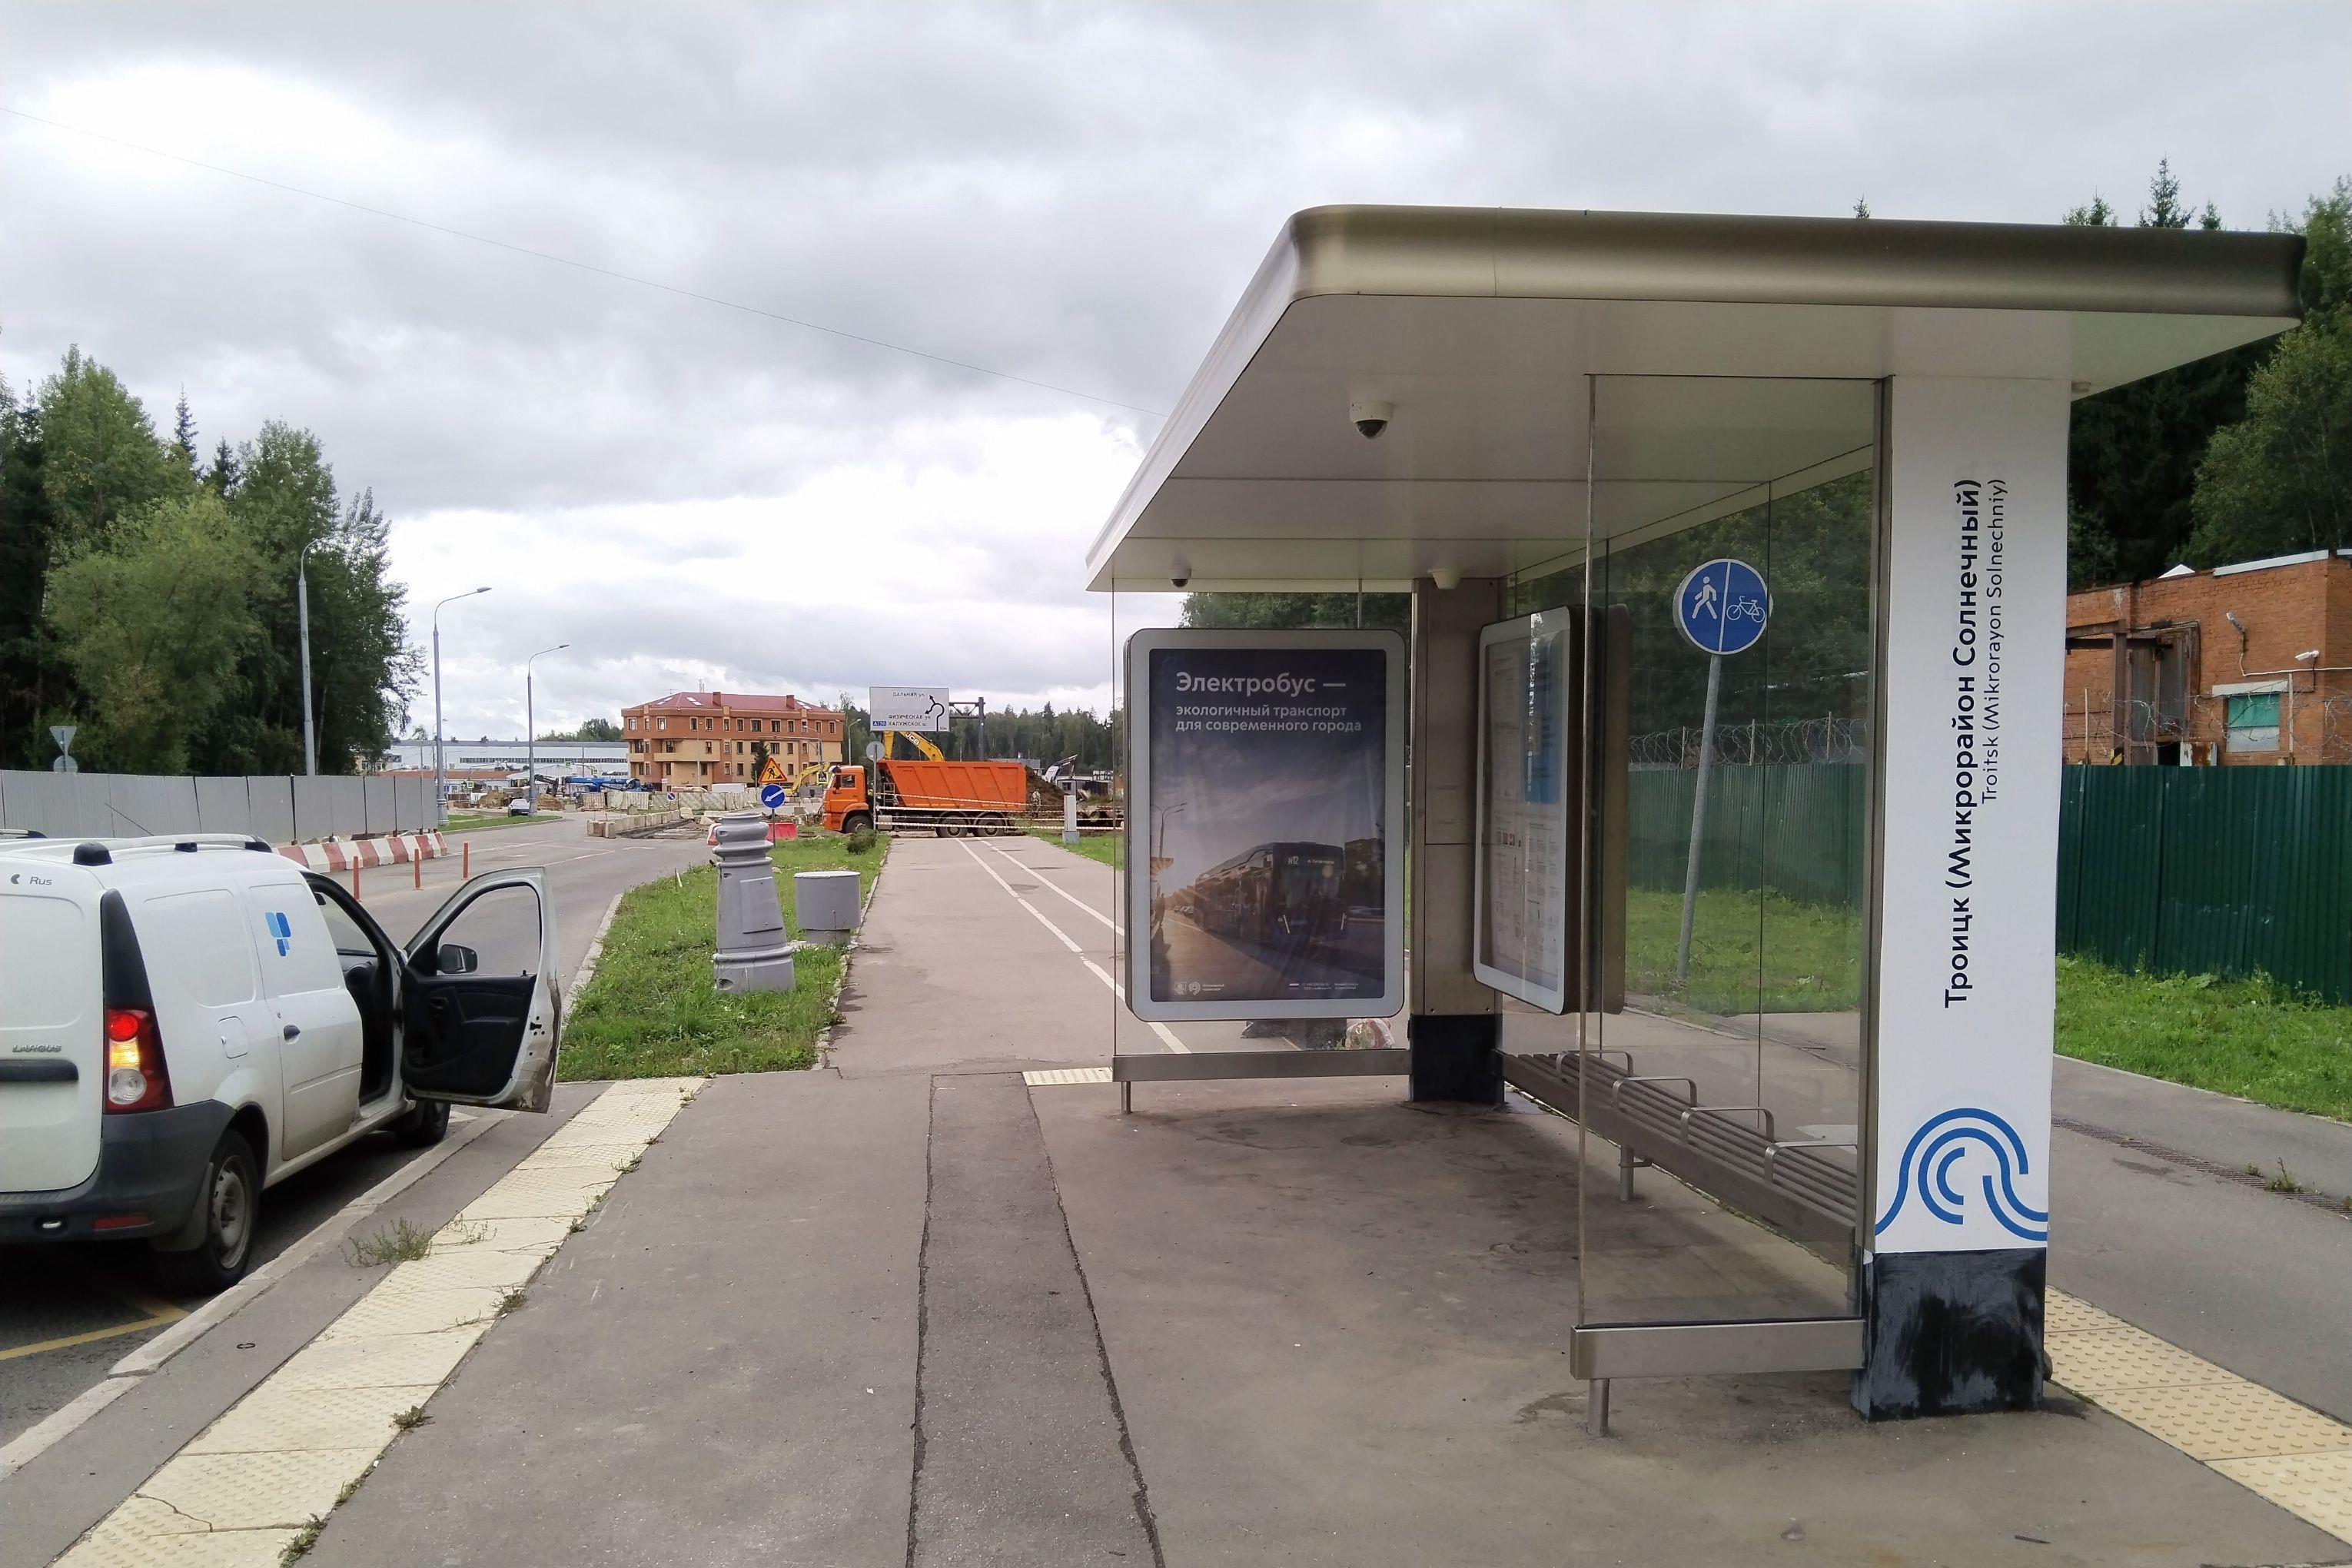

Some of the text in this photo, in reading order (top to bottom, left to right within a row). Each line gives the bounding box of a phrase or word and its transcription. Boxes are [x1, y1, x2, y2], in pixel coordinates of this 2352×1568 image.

[1982, 479, 2008, 804] Troitsk (Mikrorayon Solnechniy)
[1176, 671, 1315, 697] Электробус
[1176, 705, 1347, 719] экологичный транспорт
[1175, 720, 1362, 733] для современного города
[1944, 480, 1982, 1008] Троицк (Микрорайон Солнечный)
[29, 876, 52, 885] Rus
